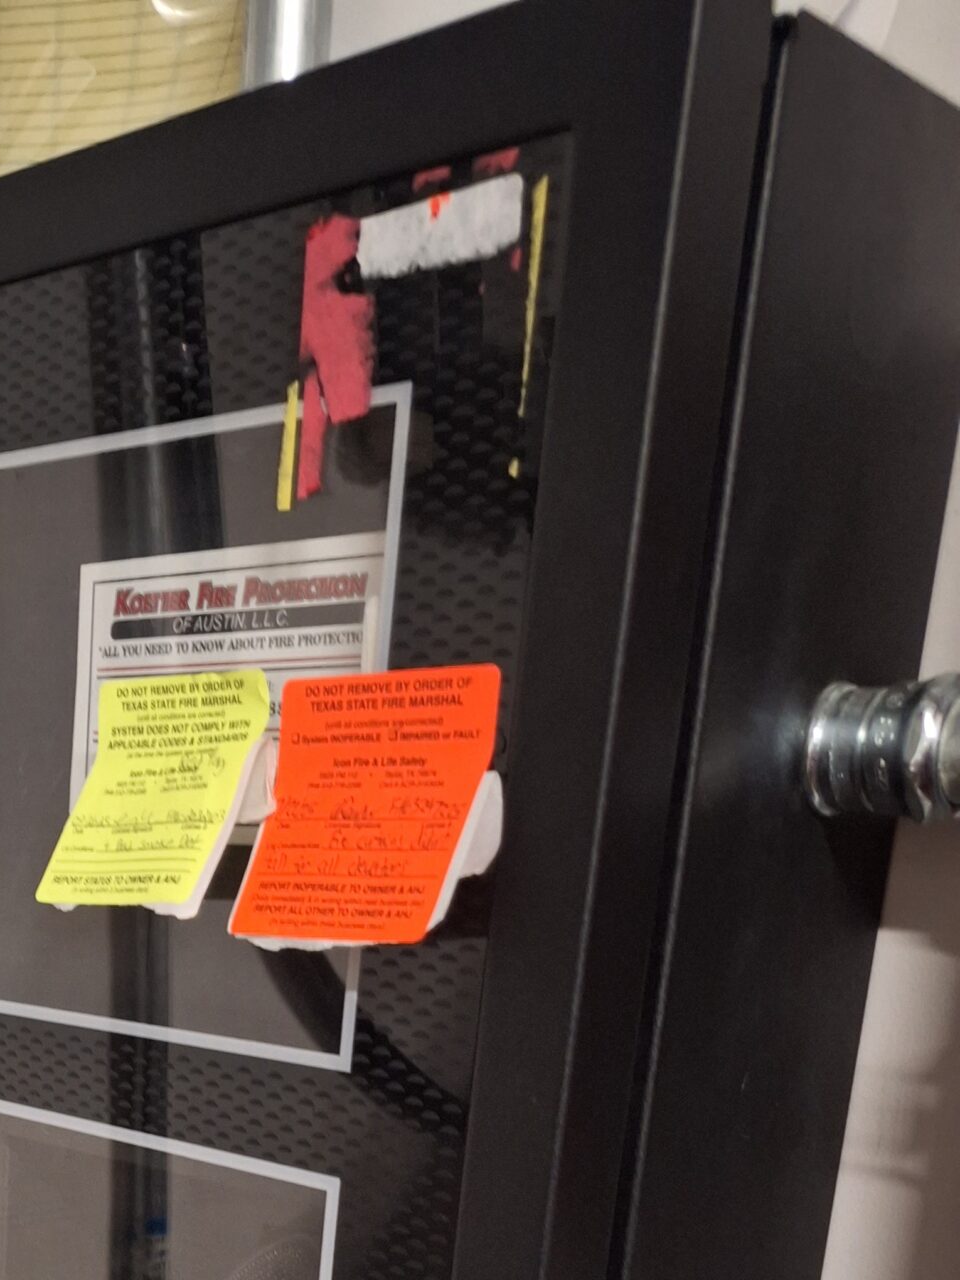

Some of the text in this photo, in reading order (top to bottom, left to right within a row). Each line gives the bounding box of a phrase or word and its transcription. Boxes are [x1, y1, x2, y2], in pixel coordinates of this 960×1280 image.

[196, 581, 237, 610] FIRE
[241, 572, 369, 607] PROTECTION
[173, 616, 192, 634] OF
[121, 645, 142, 658] YOU
[144, 643, 172, 656] NEED
[177, 642, 190, 655] TO
[192, 640, 224, 653] KNOW
[228, 637, 266, 650] ABOUT
[269, 635, 294, 648] FIRE
[116, 679, 245, 698] DO NOT REMOVE BY ORDER OF
[305, 677, 472, 697] DO NOT REMOVE BY ORDER OF
[122, 695, 242, 712] TEXAS STATE FIRE MARSHAL
[311, 694, 463, 713] TEXAS STATE FIRE MARSHAL
[112, 726, 144, 737] SYSTEM
[147, 724, 169, 735] DOES
[171, 722, 188, 733] NOT
[191, 721, 225, 732] COMPLY
[330, 733, 381, 743] INOPERABLE
